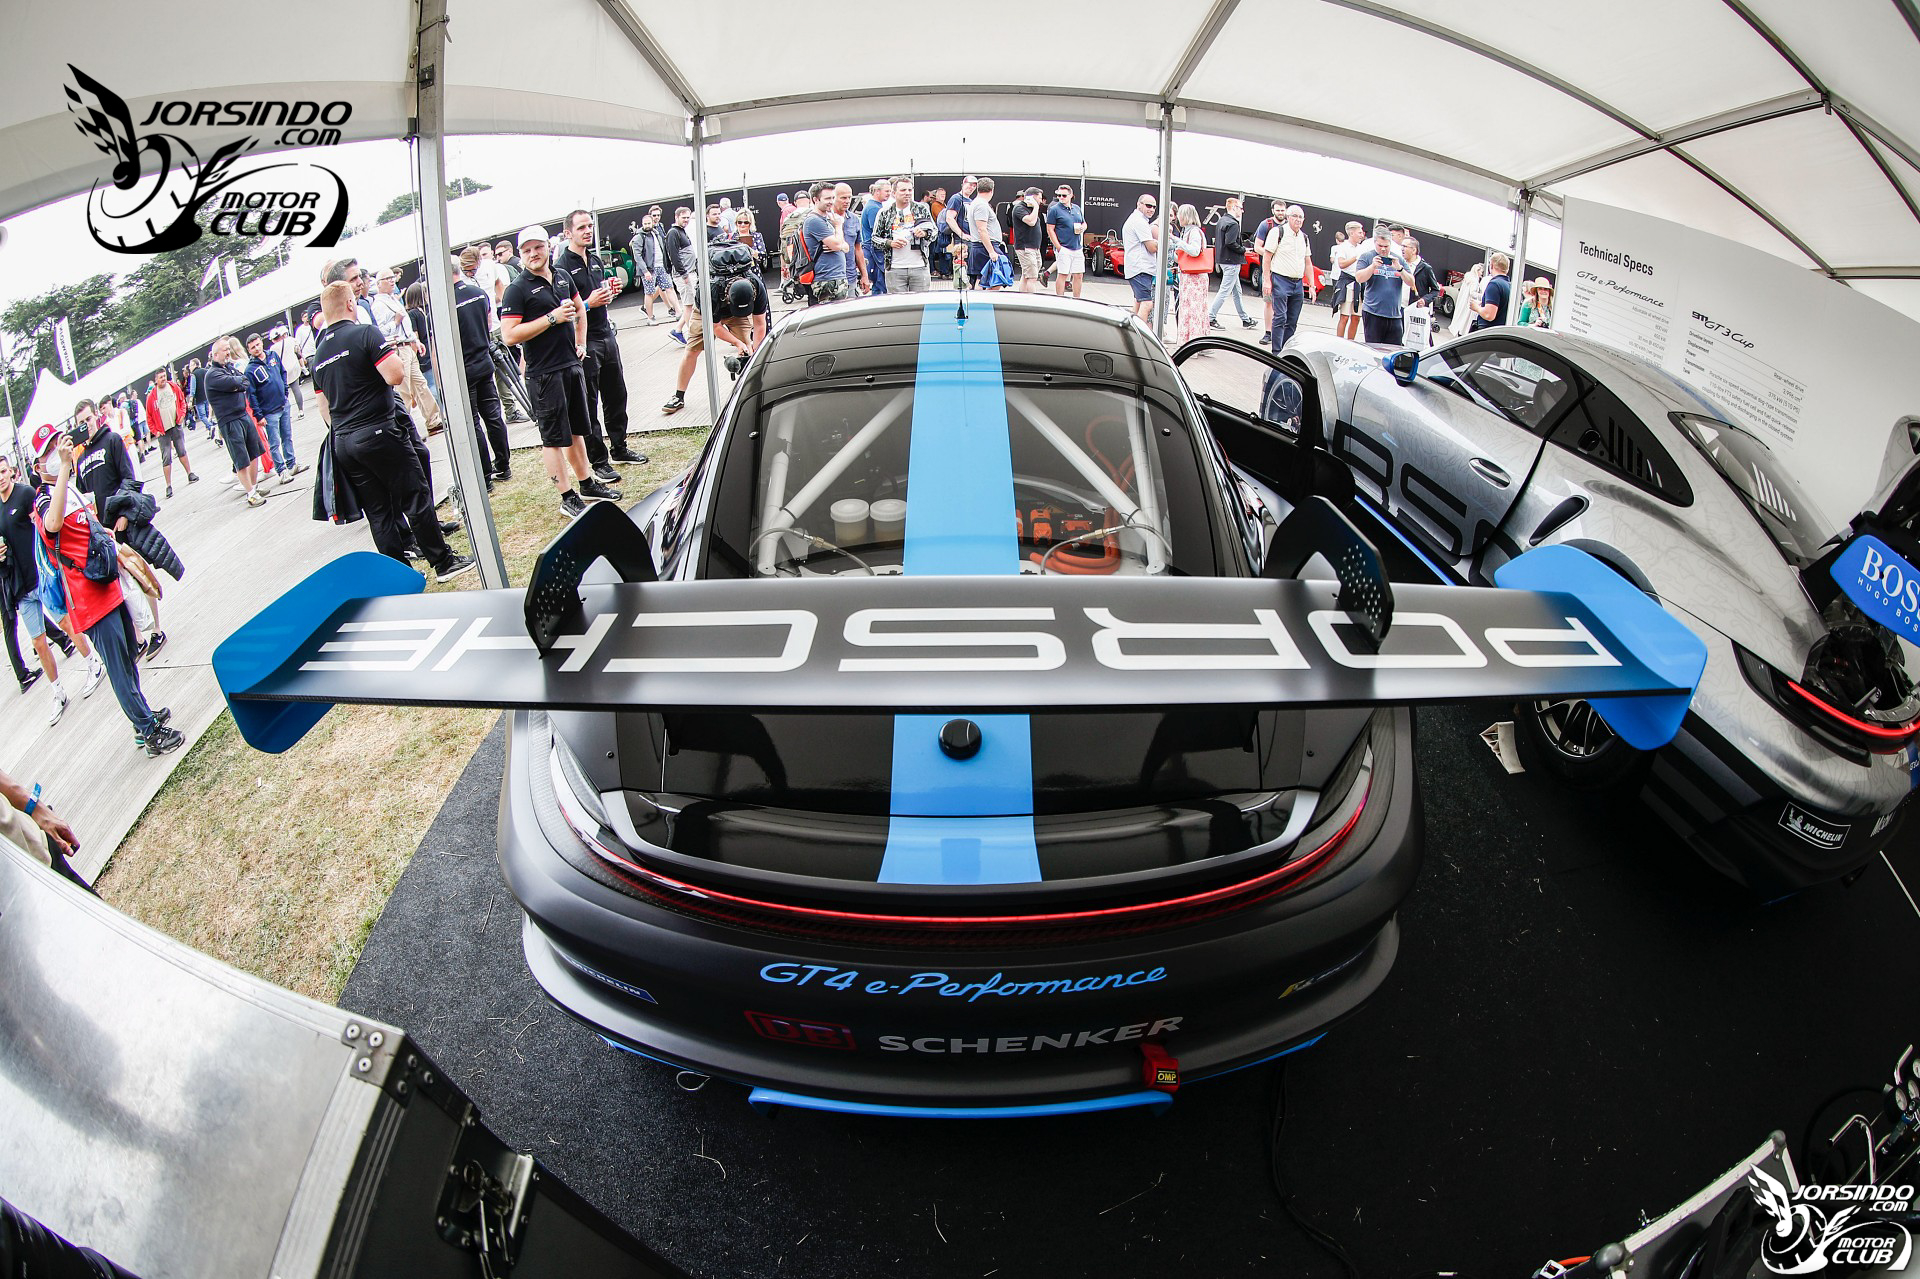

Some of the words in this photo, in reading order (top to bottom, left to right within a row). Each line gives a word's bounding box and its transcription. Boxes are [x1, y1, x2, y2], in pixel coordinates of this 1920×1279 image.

[1579, 241, 1622, 266] Technical
[1623, 254, 1654, 276] Specs
[1576, 271, 1598, 282] GT4
[1598, 280, 1664, 308] e-Performance
[1731, 333, 1755, 349] Cup
[1861, 545, 1920, 620] BOS
[1858, 577, 1889, 606] HUGO
[1896, 608, 1919, 632] BOS
[298, 607, 1623, 673] PORSCHE
[1803, 822, 1843, 842] MICHELIN
[760, 963, 859, 990] GT4
[865, 966, 1167, 1002] e-Performance
[878, 1016, 1184, 1053] SCHENKER
[1157, 1072, 1177, 1081] OMP
